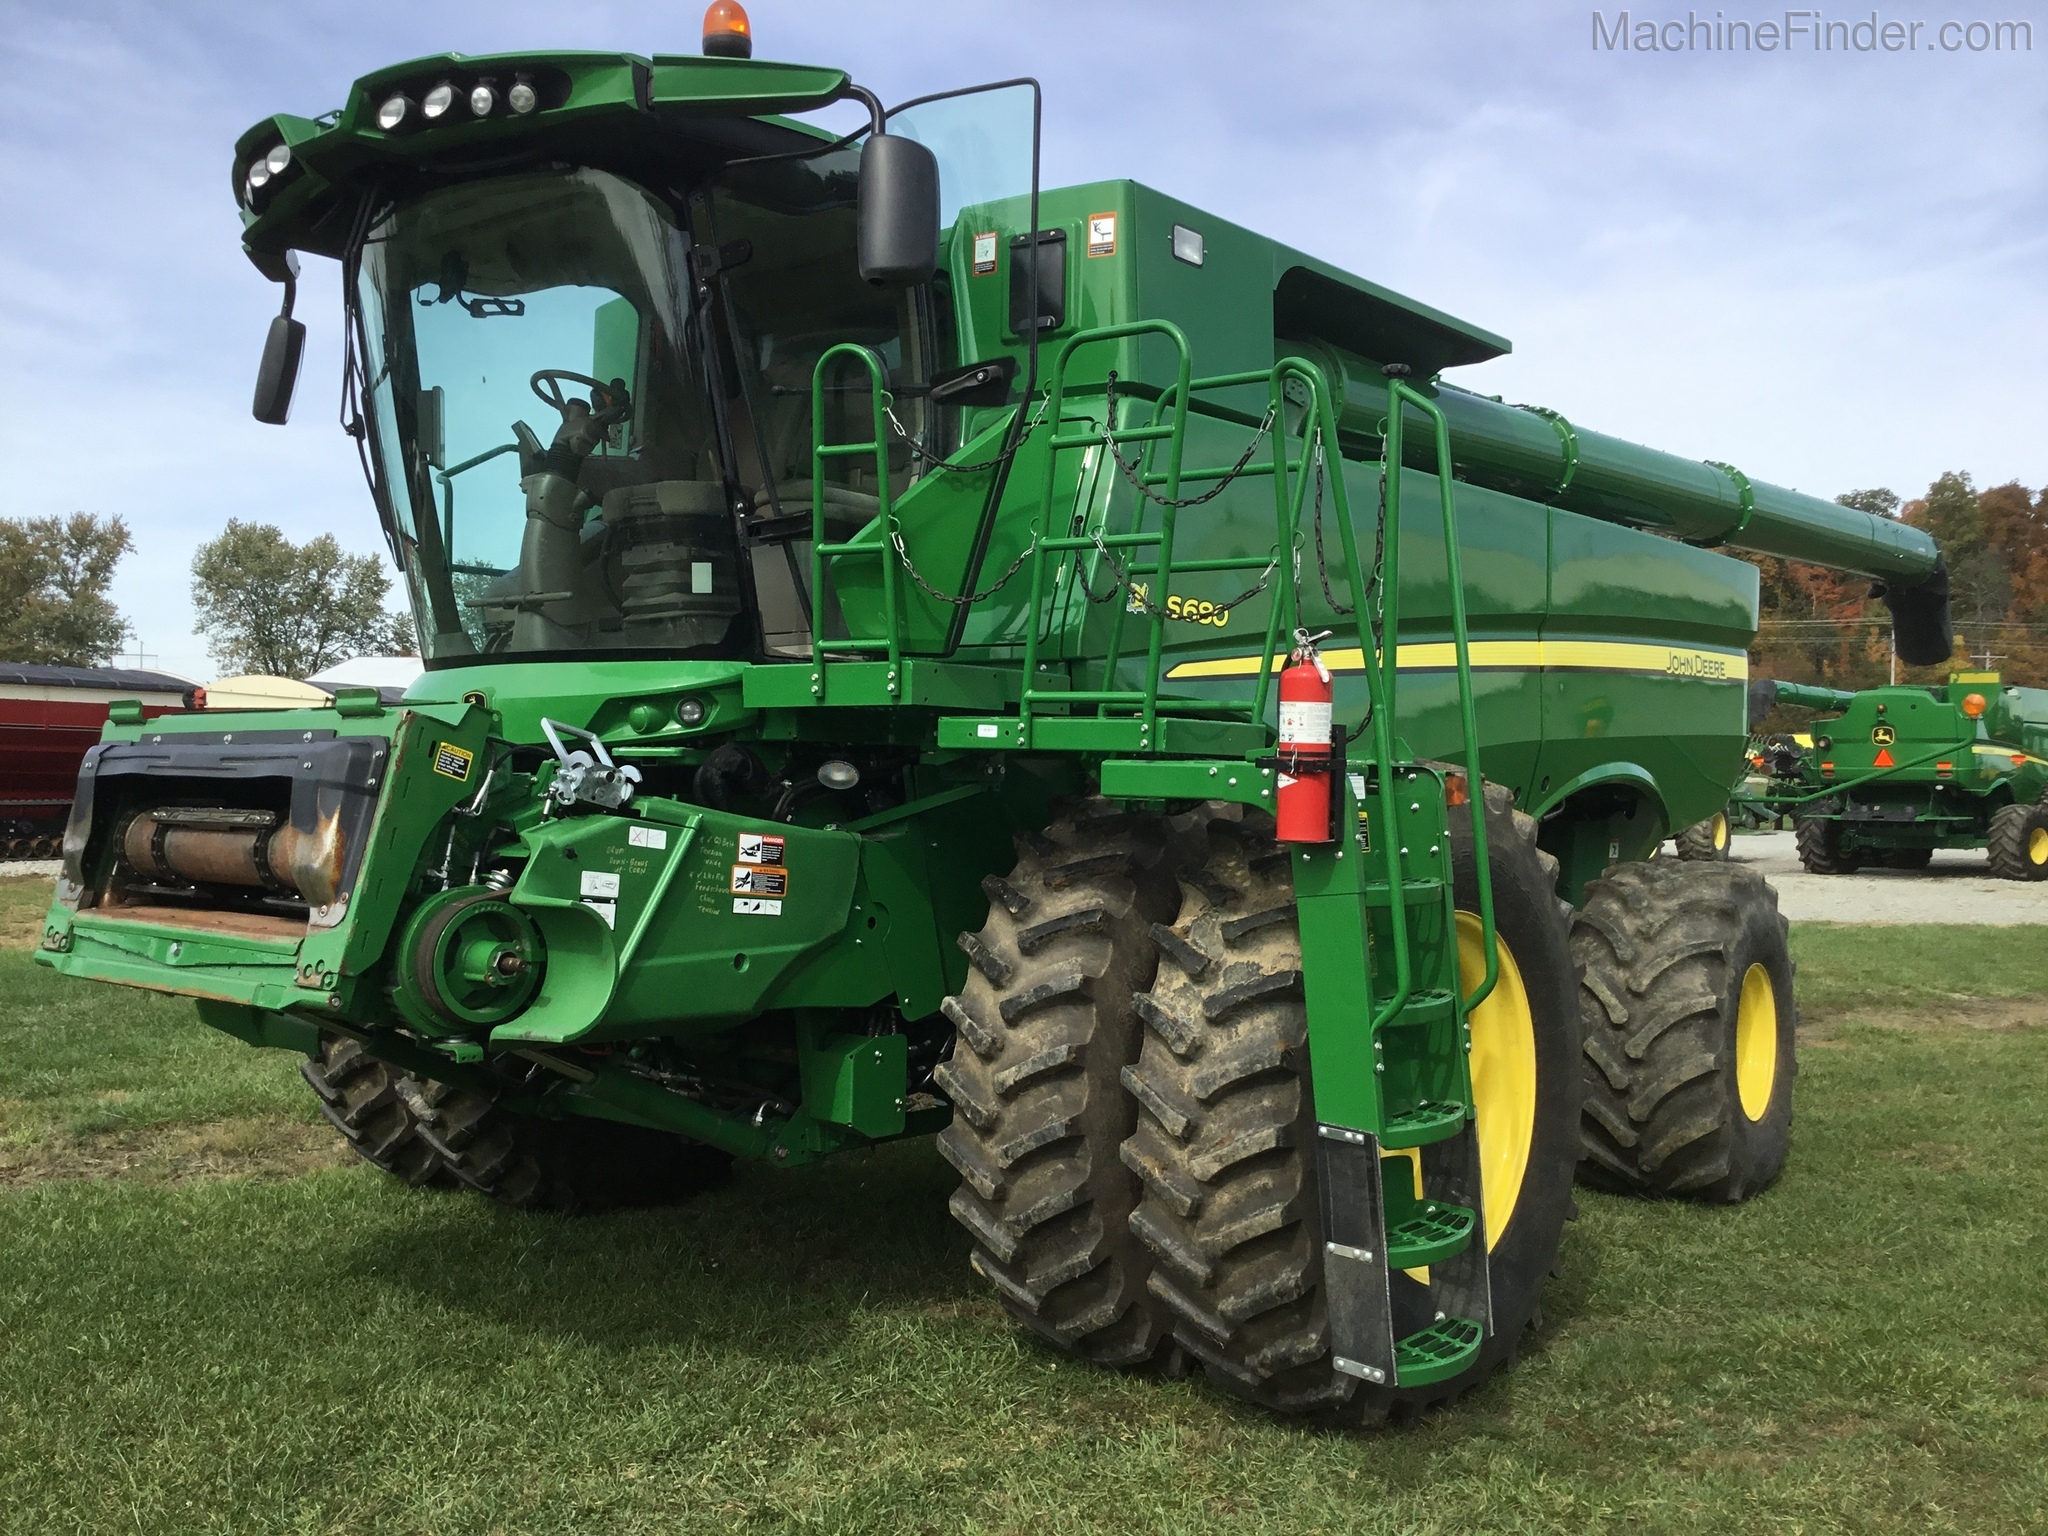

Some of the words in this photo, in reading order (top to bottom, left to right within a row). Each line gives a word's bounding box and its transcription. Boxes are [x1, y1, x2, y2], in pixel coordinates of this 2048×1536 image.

[1666, 651, 1693, 673] JOHN
[1695, 654, 1726, 677] DEERE
[446, 745, 471, 759] CAUTION
